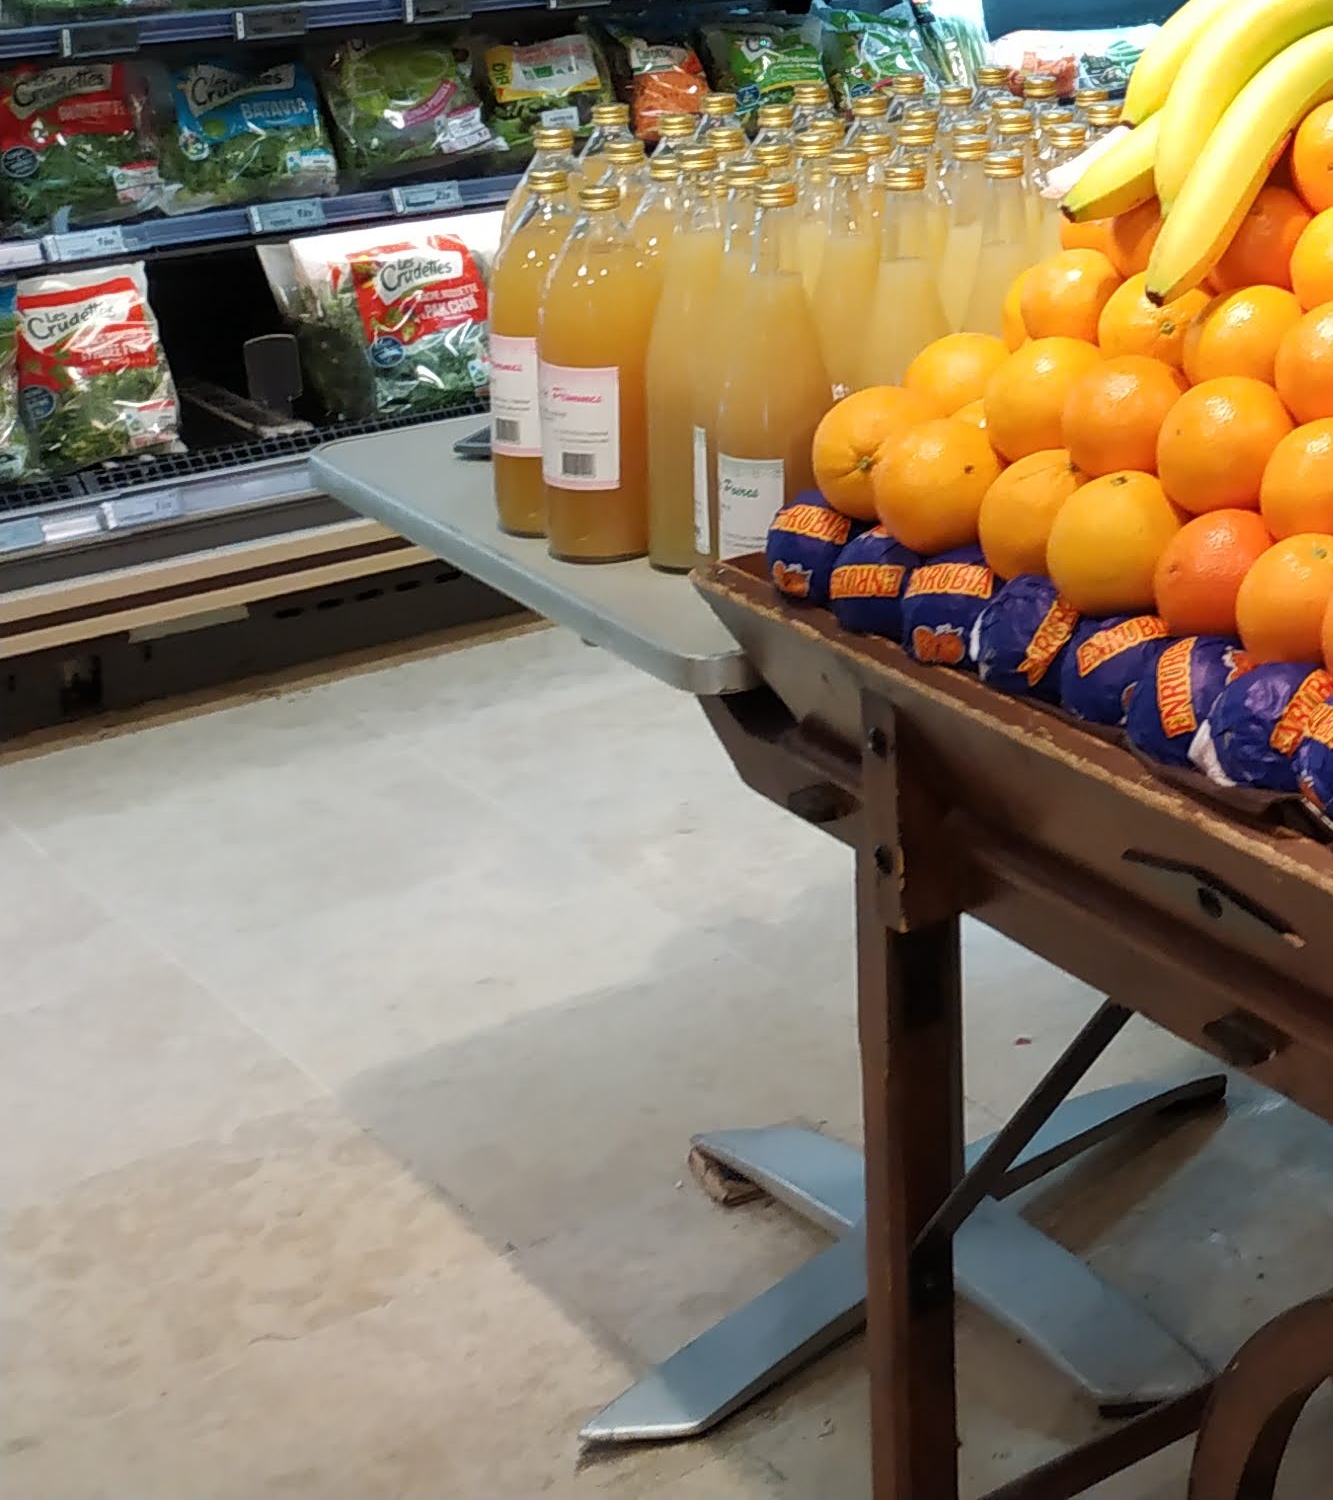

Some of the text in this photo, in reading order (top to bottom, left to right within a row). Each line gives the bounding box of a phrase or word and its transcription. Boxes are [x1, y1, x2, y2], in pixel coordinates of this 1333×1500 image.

[240, 99, 308, 119] BATAVIA
[380, 259, 453, 292] Crudettes
[46, 311, 67, 324] Les
